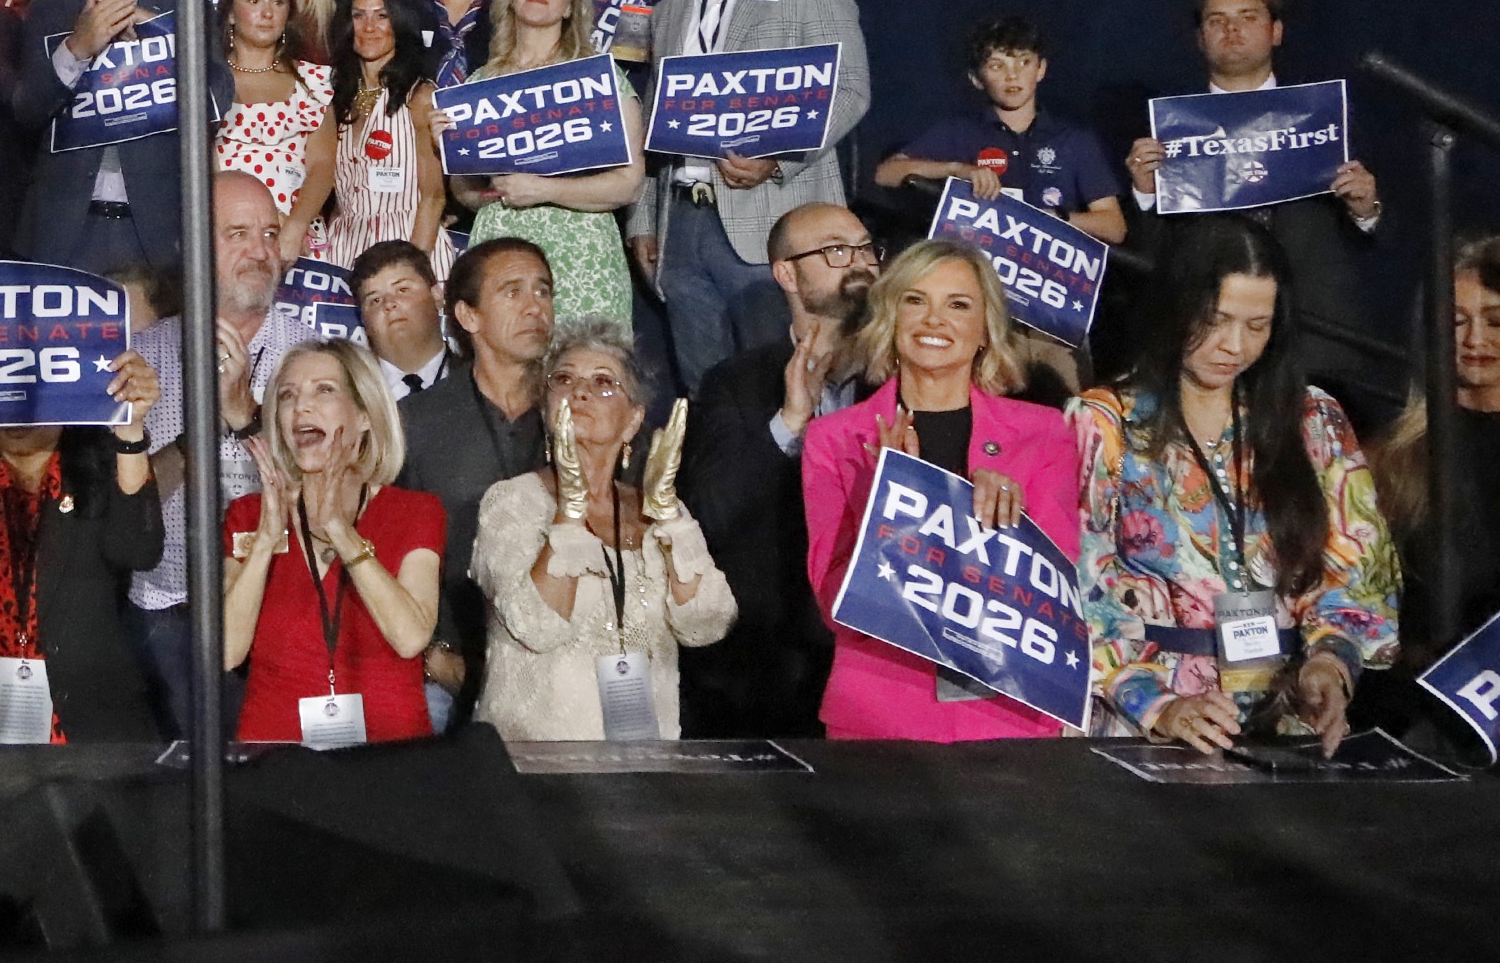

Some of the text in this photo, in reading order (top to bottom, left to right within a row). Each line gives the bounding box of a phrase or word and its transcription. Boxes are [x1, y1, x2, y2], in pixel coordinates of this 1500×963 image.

[101, 64, 169, 85] SENA
[667, 62, 832, 97] PAXTON
[71, 78, 176, 119] 2026
[443, 73, 612, 130] PAXTON
[664, 89, 829, 110] FOR SENATE
[449, 99, 615, 141] FOR SENATE
[478, 117, 593, 159] 2026
[687, 106, 801, 137] 2026
[1165, 123, 1339, 158] #TexasFirst
[367, 138, 392, 151] PAXTON
[947, 196, 1100, 282] PAXTON
[285, 268, 353, 296] TON
[981, 249, 1068, 310] 026
[881, 480, 1084, 620] PAXTON
[878, 524, 1088, 638] FOR SENATE
[902, 564, 1058, 665] 2026
[1233, 626, 1268, 639] PAXTON
